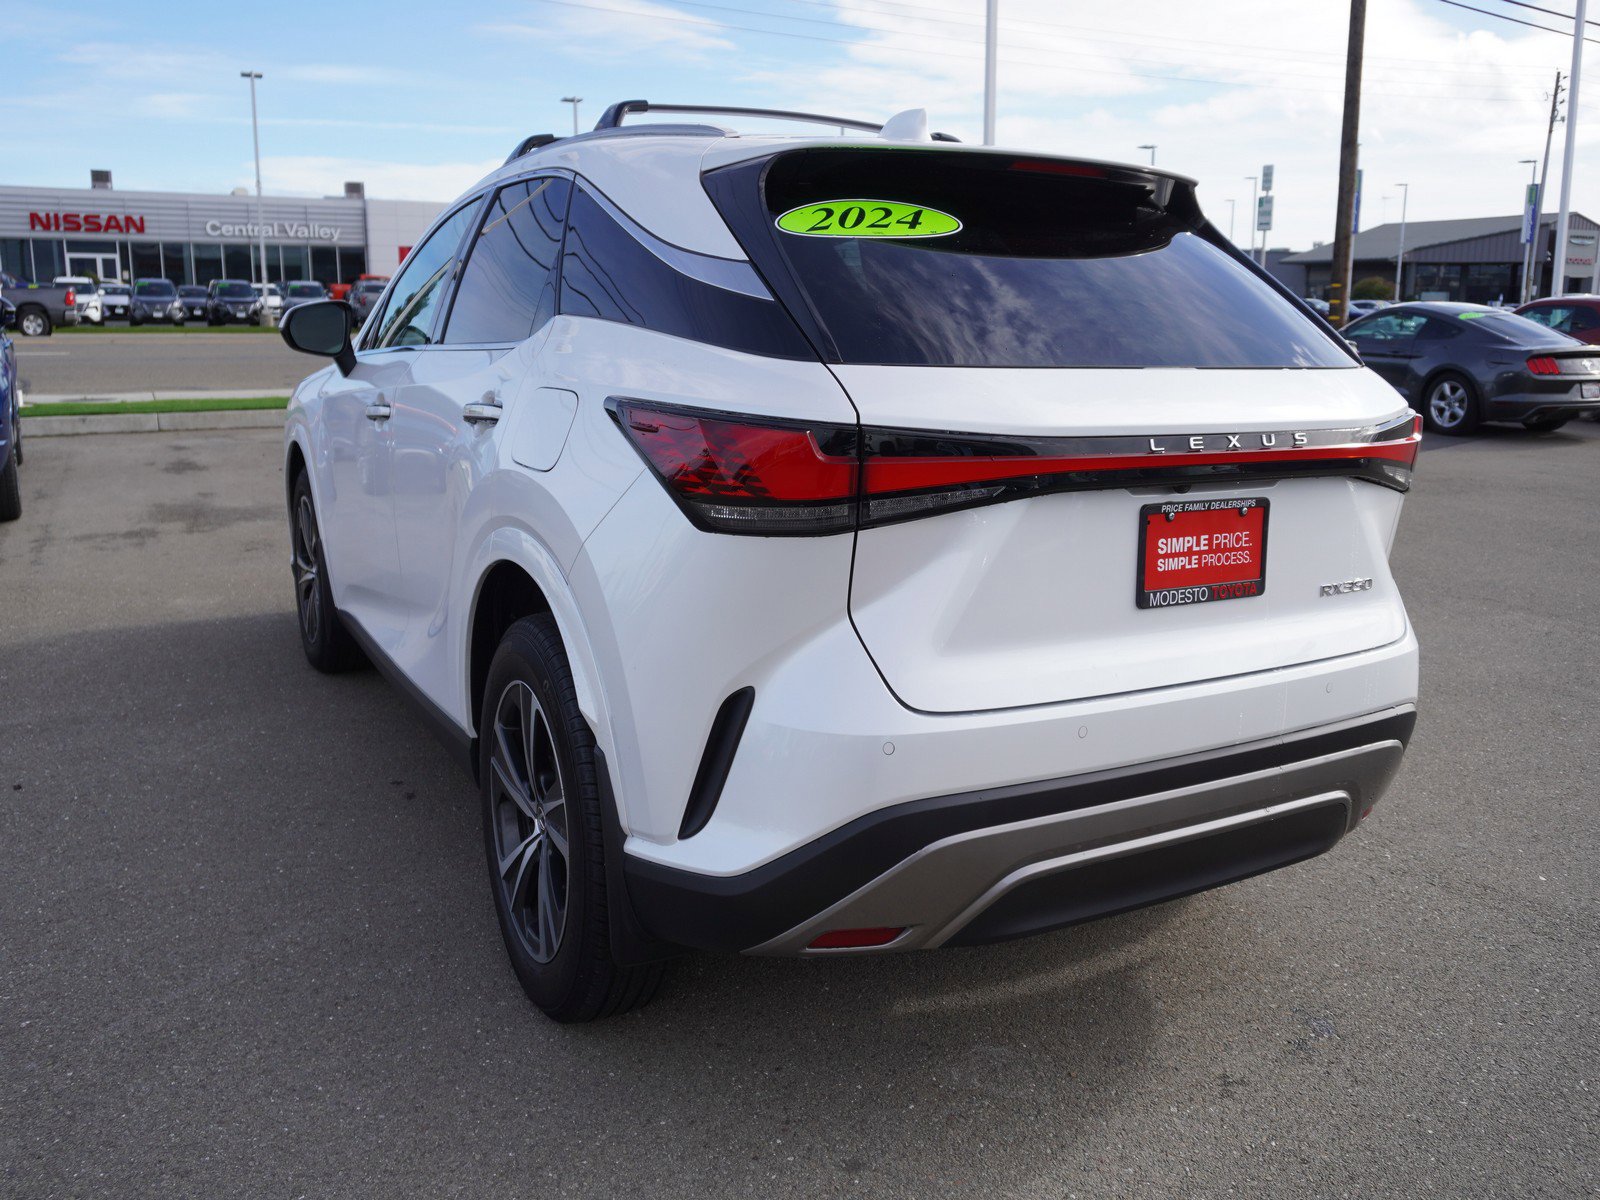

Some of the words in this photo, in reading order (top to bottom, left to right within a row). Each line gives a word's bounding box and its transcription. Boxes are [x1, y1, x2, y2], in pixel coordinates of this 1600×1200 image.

[29, 212, 145, 233] NISSAN
[806, 206, 924, 232] 2024
[206, 220, 278, 237] Central
[285, 221, 341, 241] Valley
[1150, 432, 1308, 451] LEXUS
[1161, 504, 1183, 513] PRICE
[1184, 502, 1209, 511] FAMILY
[1210, 499, 1256, 510] DEALERSHIPS
[1157, 535, 1209, 554] SIMPLE
[1213, 531, 1252, 549] PRICE.
[1157, 555, 1198, 572] SIMPLE
[1201, 550, 1252, 567] PROCESS.
[1149, 587, 1208, 607] MODESTO
[1211, 581, 1257, 600] TOYOTA
